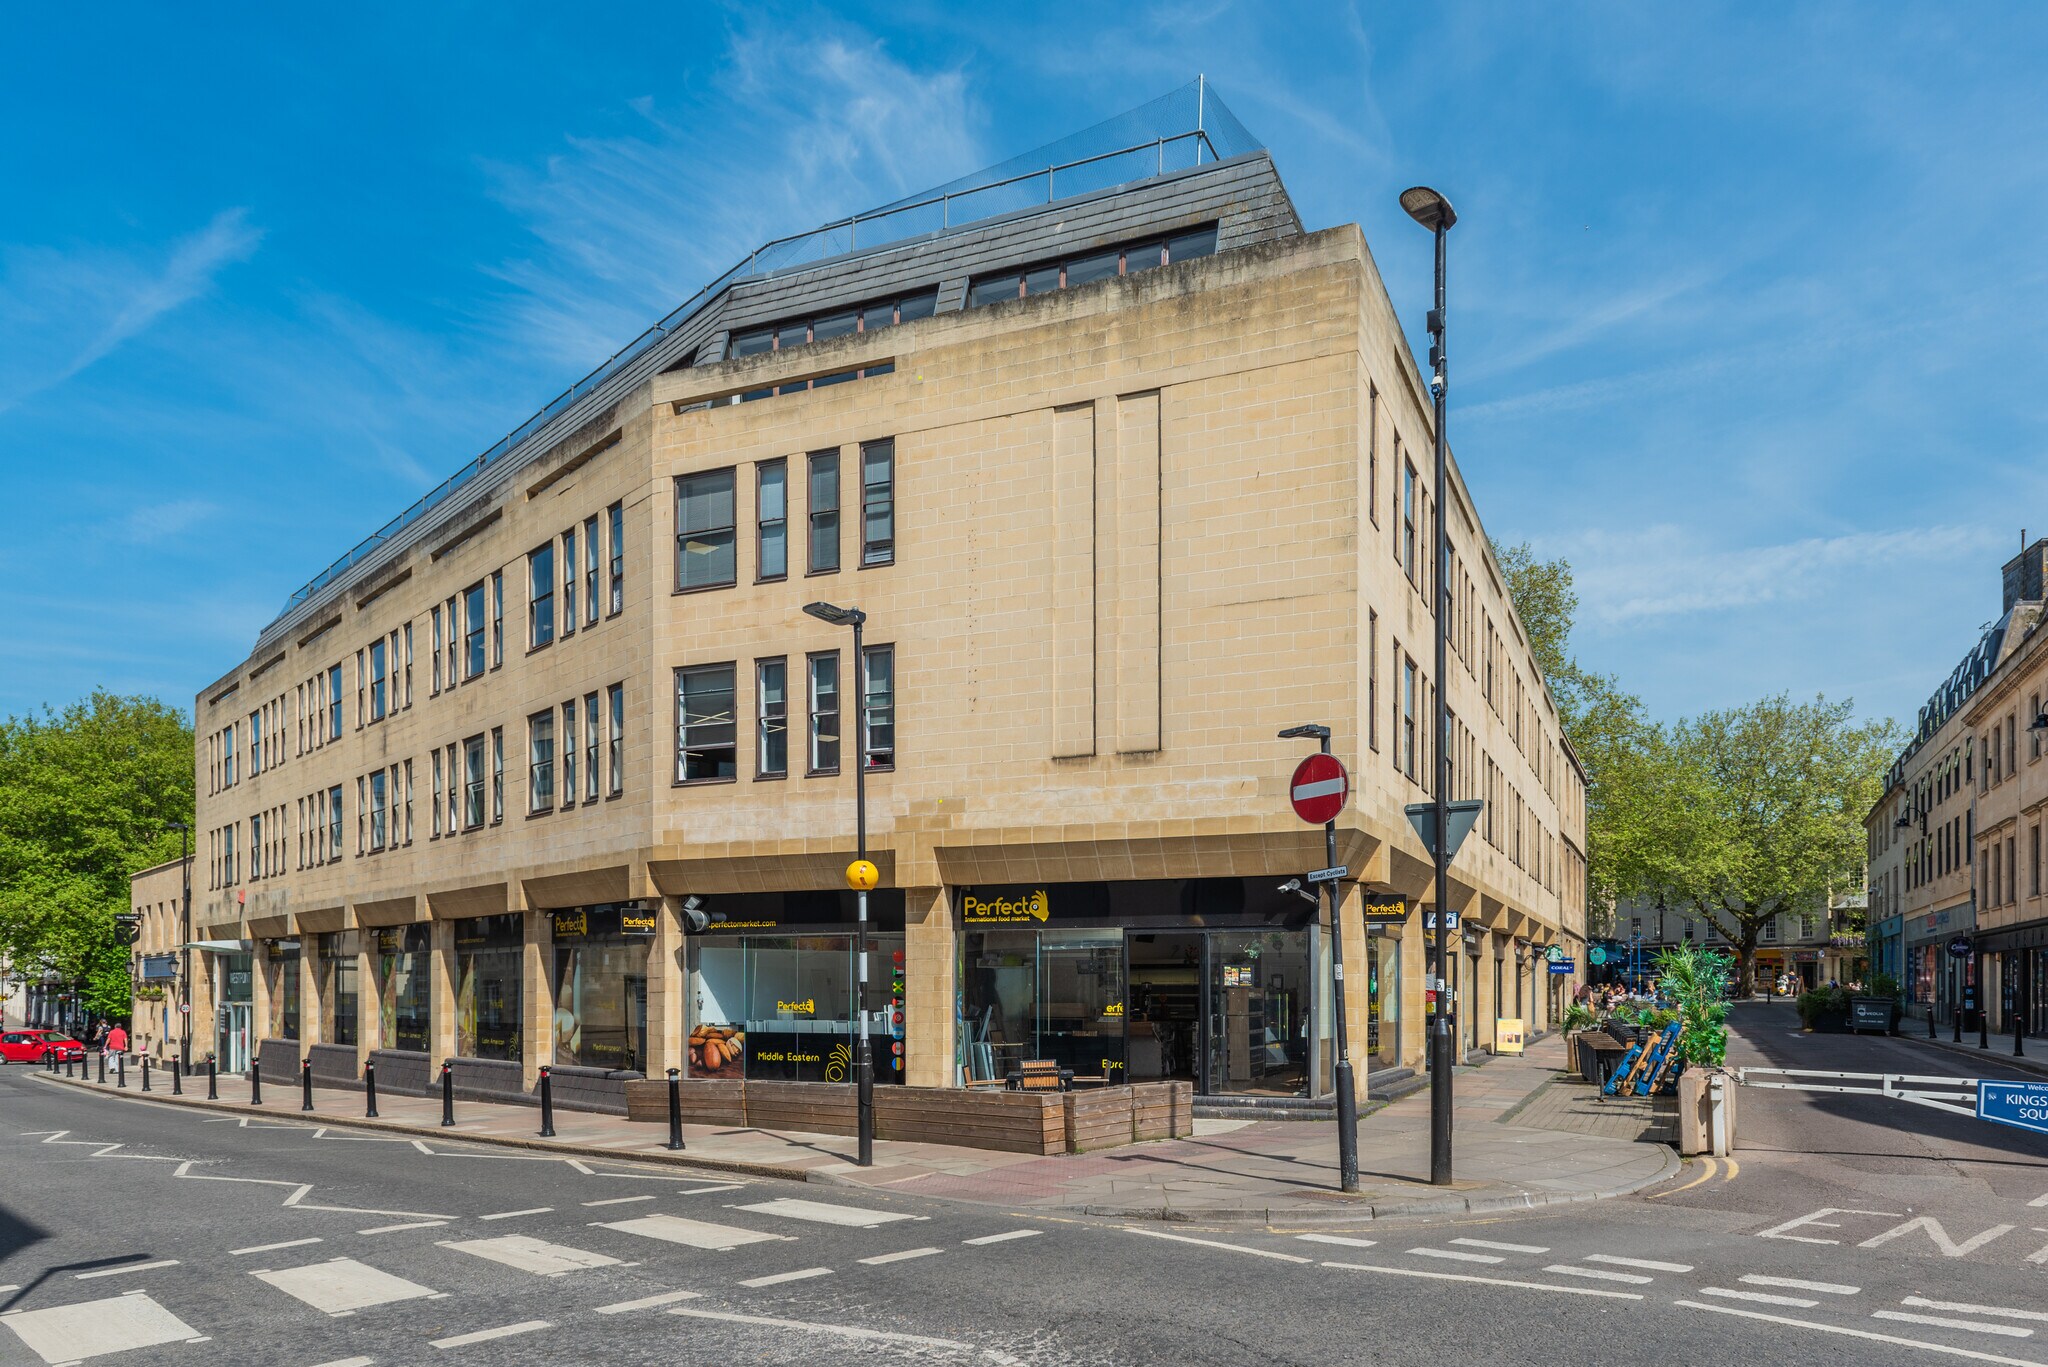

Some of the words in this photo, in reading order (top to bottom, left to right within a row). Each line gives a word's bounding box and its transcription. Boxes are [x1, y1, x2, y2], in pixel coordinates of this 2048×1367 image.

[1310, 872, 1326, 880] Except
[1327, 869, 1345, 877] Cyclists
[964, 892, 1049, 919] Perfecto
[1366, 903, 1404, 914] Perfecto
[556, 914, 587, 932] Perfecto
[623, 916, 655, 927] Perfecto
[707, 920, 777, 929] .perfectomarket.com
[777, 1000, 815, 1013] Perfecto
[757, 1051, 784, 1061] Middle
[787, 1052, 820, 1062] Eastern
